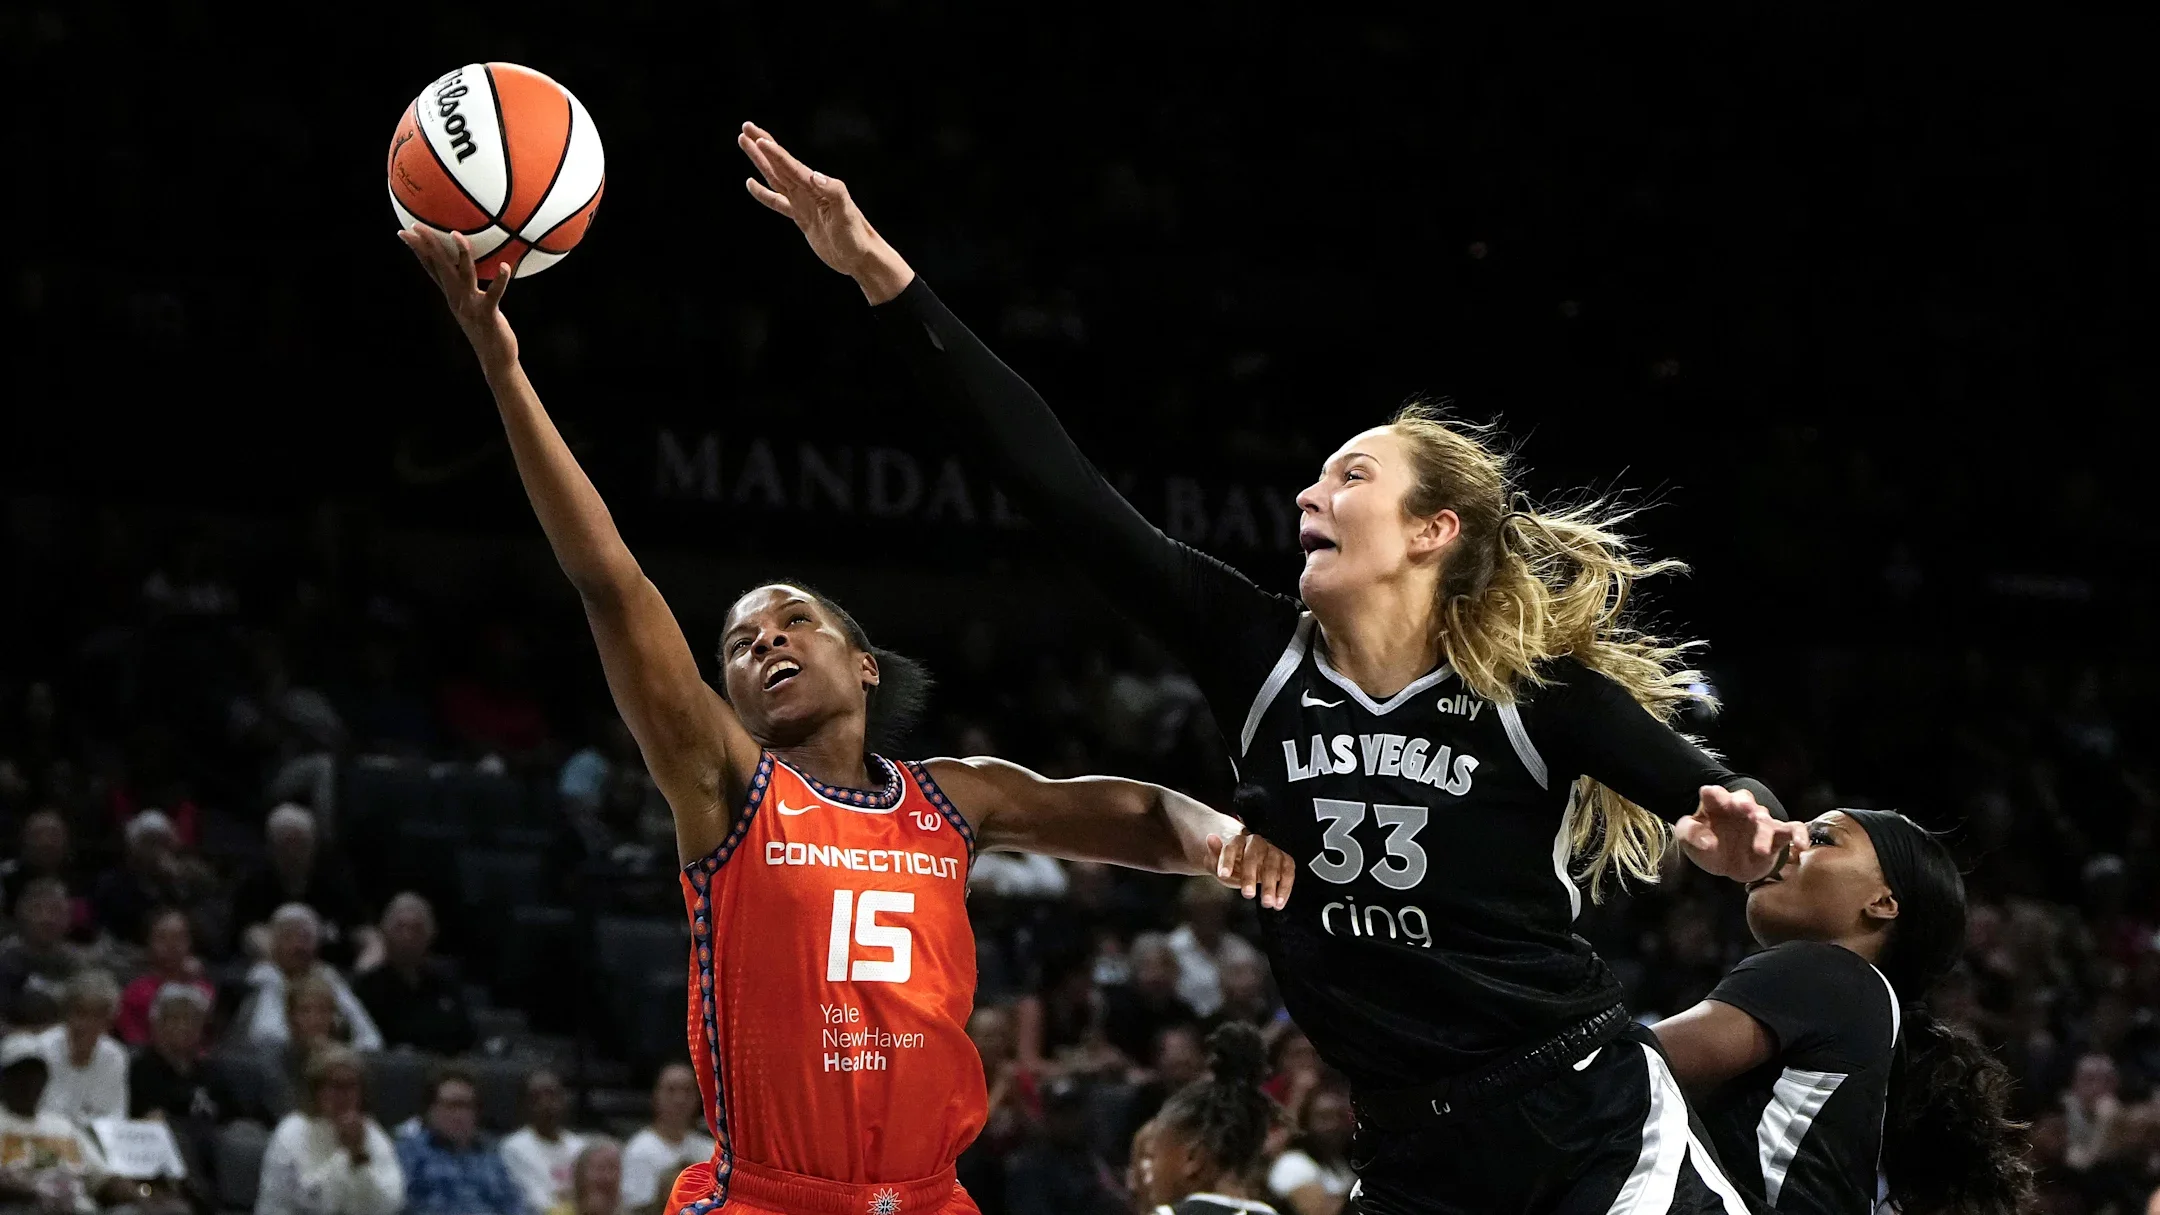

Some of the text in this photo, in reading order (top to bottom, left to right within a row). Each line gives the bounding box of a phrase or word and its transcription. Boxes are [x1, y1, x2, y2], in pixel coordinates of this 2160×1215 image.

[1437, 694, 1483, 721] ally
[1282, 733, 1480, 796] LAS VEGAS
[766, 841, 958, 880] CONNECTICUT
[1308, 797, 1429, 890] 33
[826, 889, 915, 984] 15
[1321, 895, 1433, 948] ring
[820, 1003, 860, 1024] Yale
[822, 1027, 924, 1049] NewHaven
[823, 1051, 887, 1073] Health
